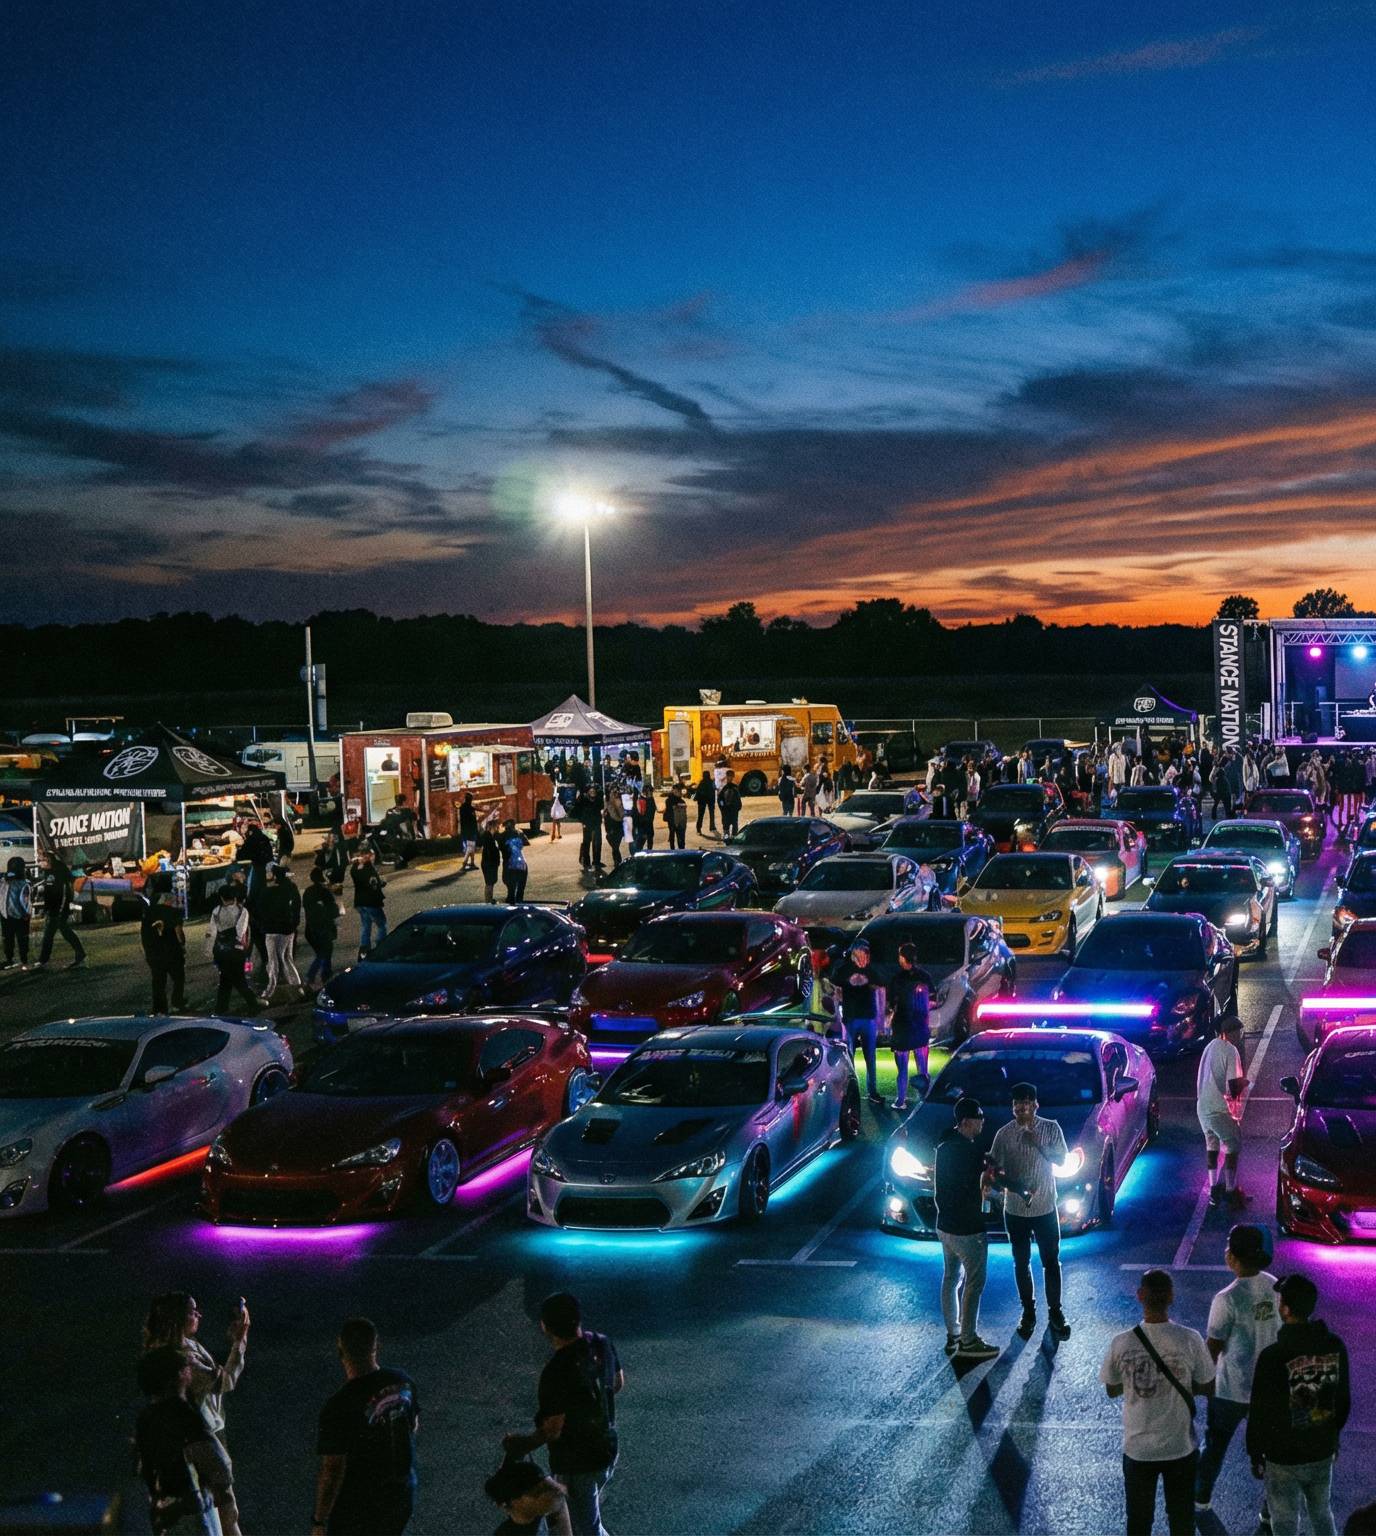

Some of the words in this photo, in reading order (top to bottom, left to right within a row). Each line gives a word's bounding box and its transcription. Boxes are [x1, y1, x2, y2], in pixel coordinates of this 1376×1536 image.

[1219, 624, 1239, 688] STANCE
[1220, 690, 1240, 751] NATION
[49, 814, 90, 837] STANCE
[90, 807, 131, 831] NATION
